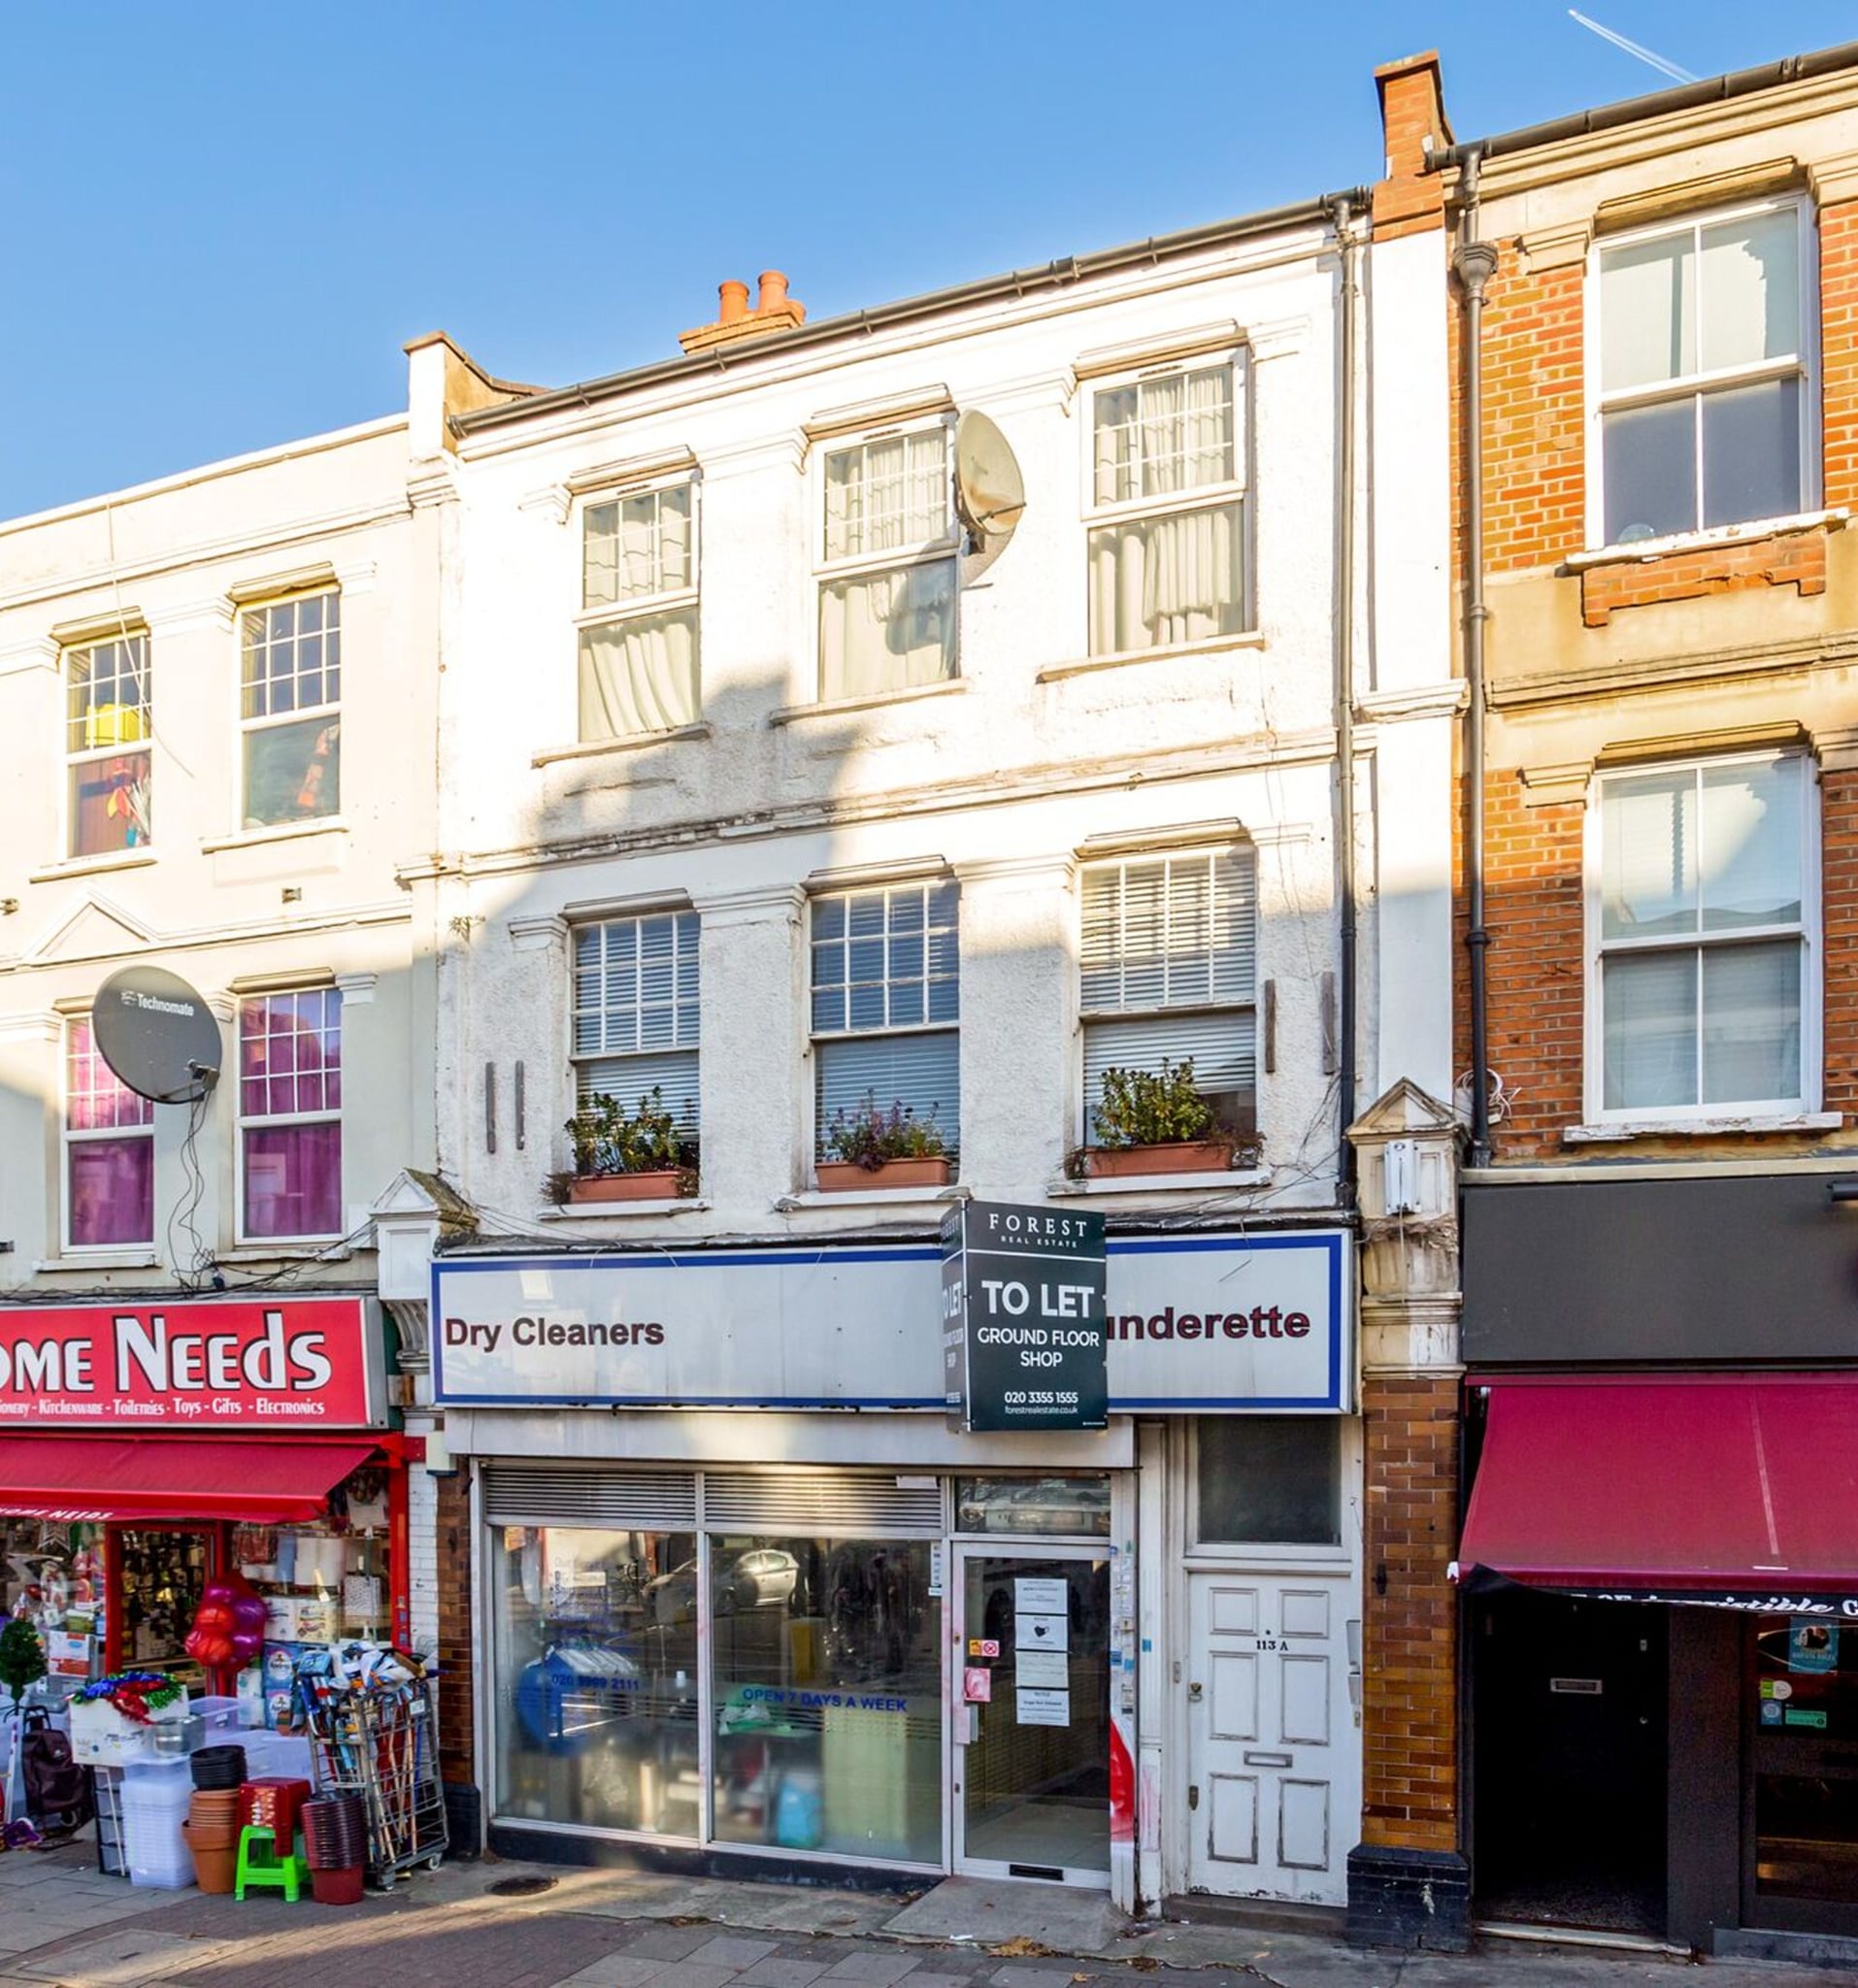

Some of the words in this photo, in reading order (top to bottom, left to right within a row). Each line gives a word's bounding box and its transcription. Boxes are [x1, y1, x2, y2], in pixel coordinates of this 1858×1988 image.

[137, 993, 194, 1016] Technomate
[988, 1213, 1087, 1238] FOREST
[1001, 1236, 1030, 1245] REAL
[1037, 1239, 1078, 1249] ESTATE
[981, 1279, 1030, 1315] TO
[1041, 1283, 1095, 1318] LET
[446, 1317, 502, 1353] Dry
[513, 1317, 664, 1346] Cleaners
[978, 1327, 1048, 1345] GROUND
[1051, 1330, 1100, 1347] FLOOR
[1020, 1350, 1063, 1368] SHOP
[1004, 1391, 1026, 1404] 020
[1028, 1391, 1054, 1404] 3355
[1056, 1391, 1078, 1404] 1555
[173, 1398, 202, 1419] Toys
[1256, 1640, 1277, 1650] 113
[1279, 1640, 1289, 1651] A
[612, 1677, 639, 1691] 2111
[743, 1688, 783, 1703] OPEN
[801, 1693, 842, 1707] DAYS
[846, 1696, 856, 1708] A
[861, 1697, 907, 1711] WEEK
